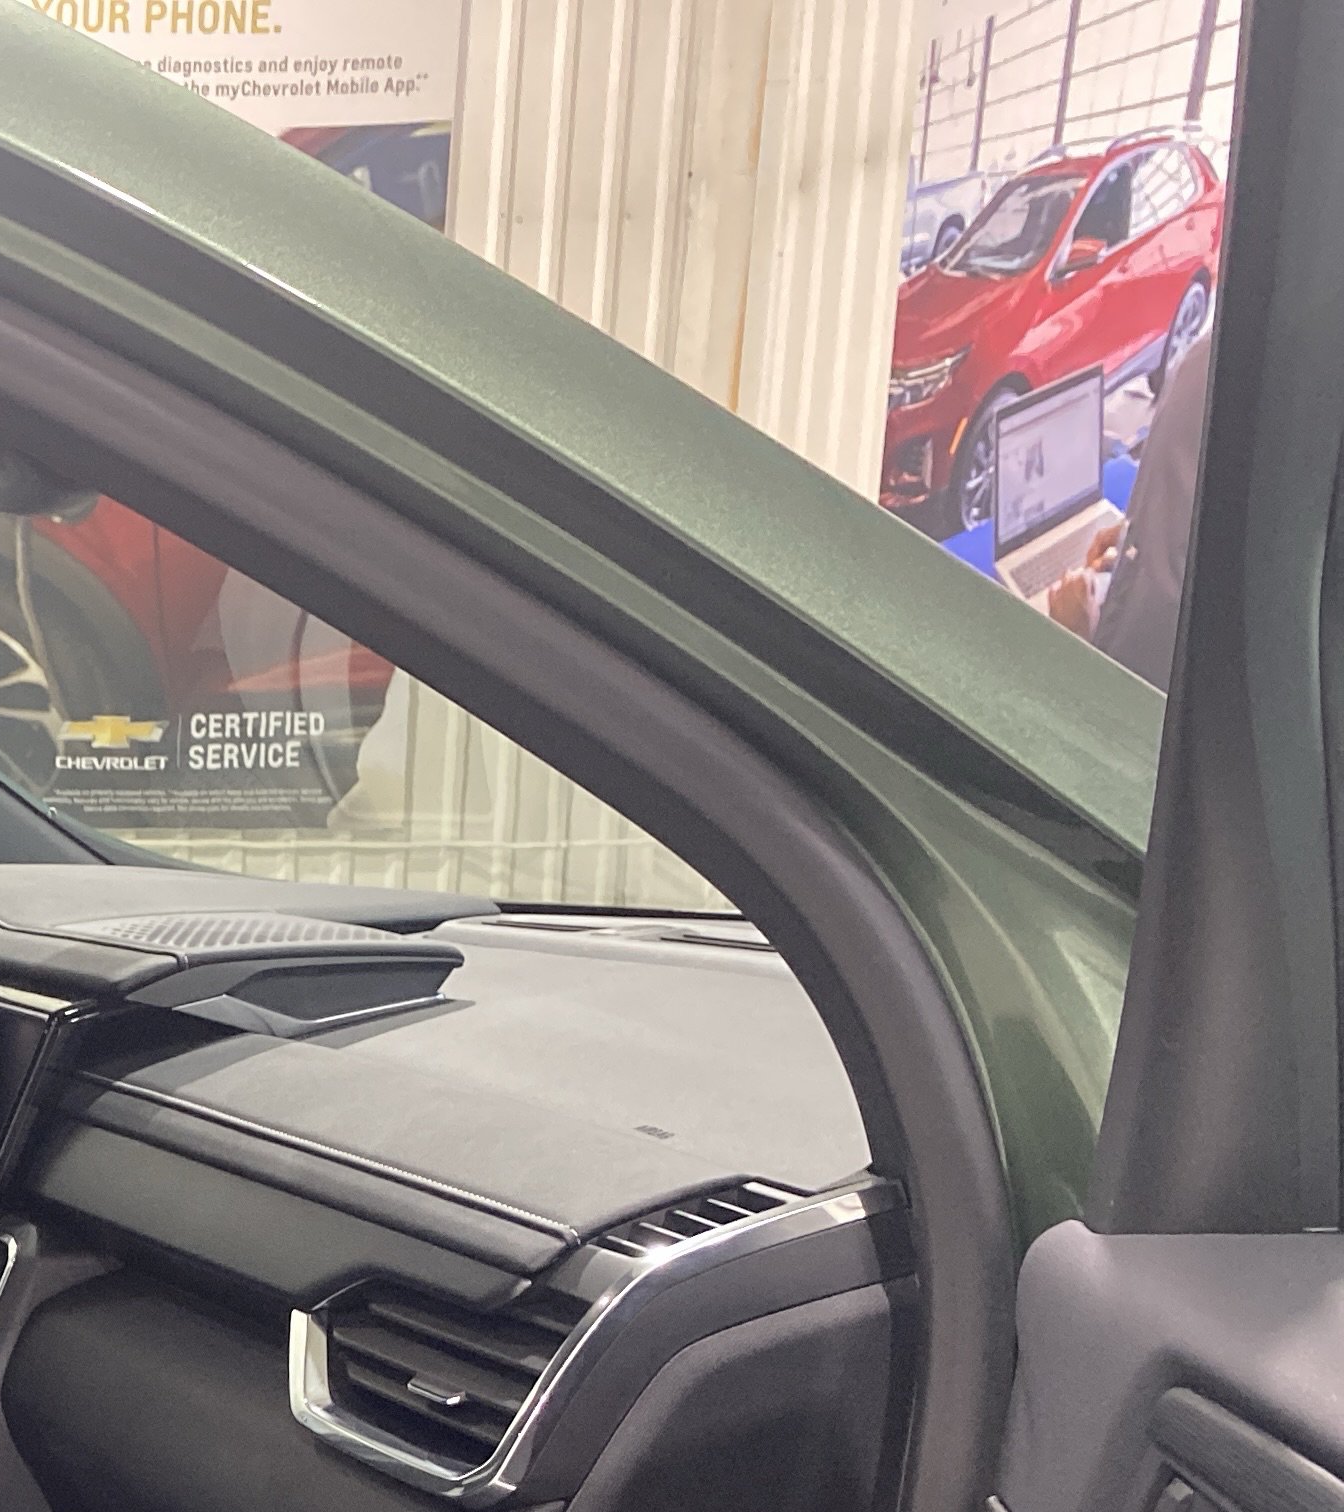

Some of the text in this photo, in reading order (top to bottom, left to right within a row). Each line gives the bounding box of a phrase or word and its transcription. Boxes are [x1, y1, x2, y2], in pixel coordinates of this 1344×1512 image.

[145, 0, 282, 34] PHONE.
[157, 56, 253, 77] diagnostics
[258, 56, 288, 73] and
[293, 56, 338, 77] enjoy
[343, 54, 403, 71] remote
[184, 80, 210, 96] he
[215, 80, 321, 100] myChevrolet
[326, 78, 379, 95] Mobile
[190, 711, 325, 739] CERTIFIED
[55, 755, 169, 771] CHEVROLET
[188, 741, 302, 770] SERVICE
